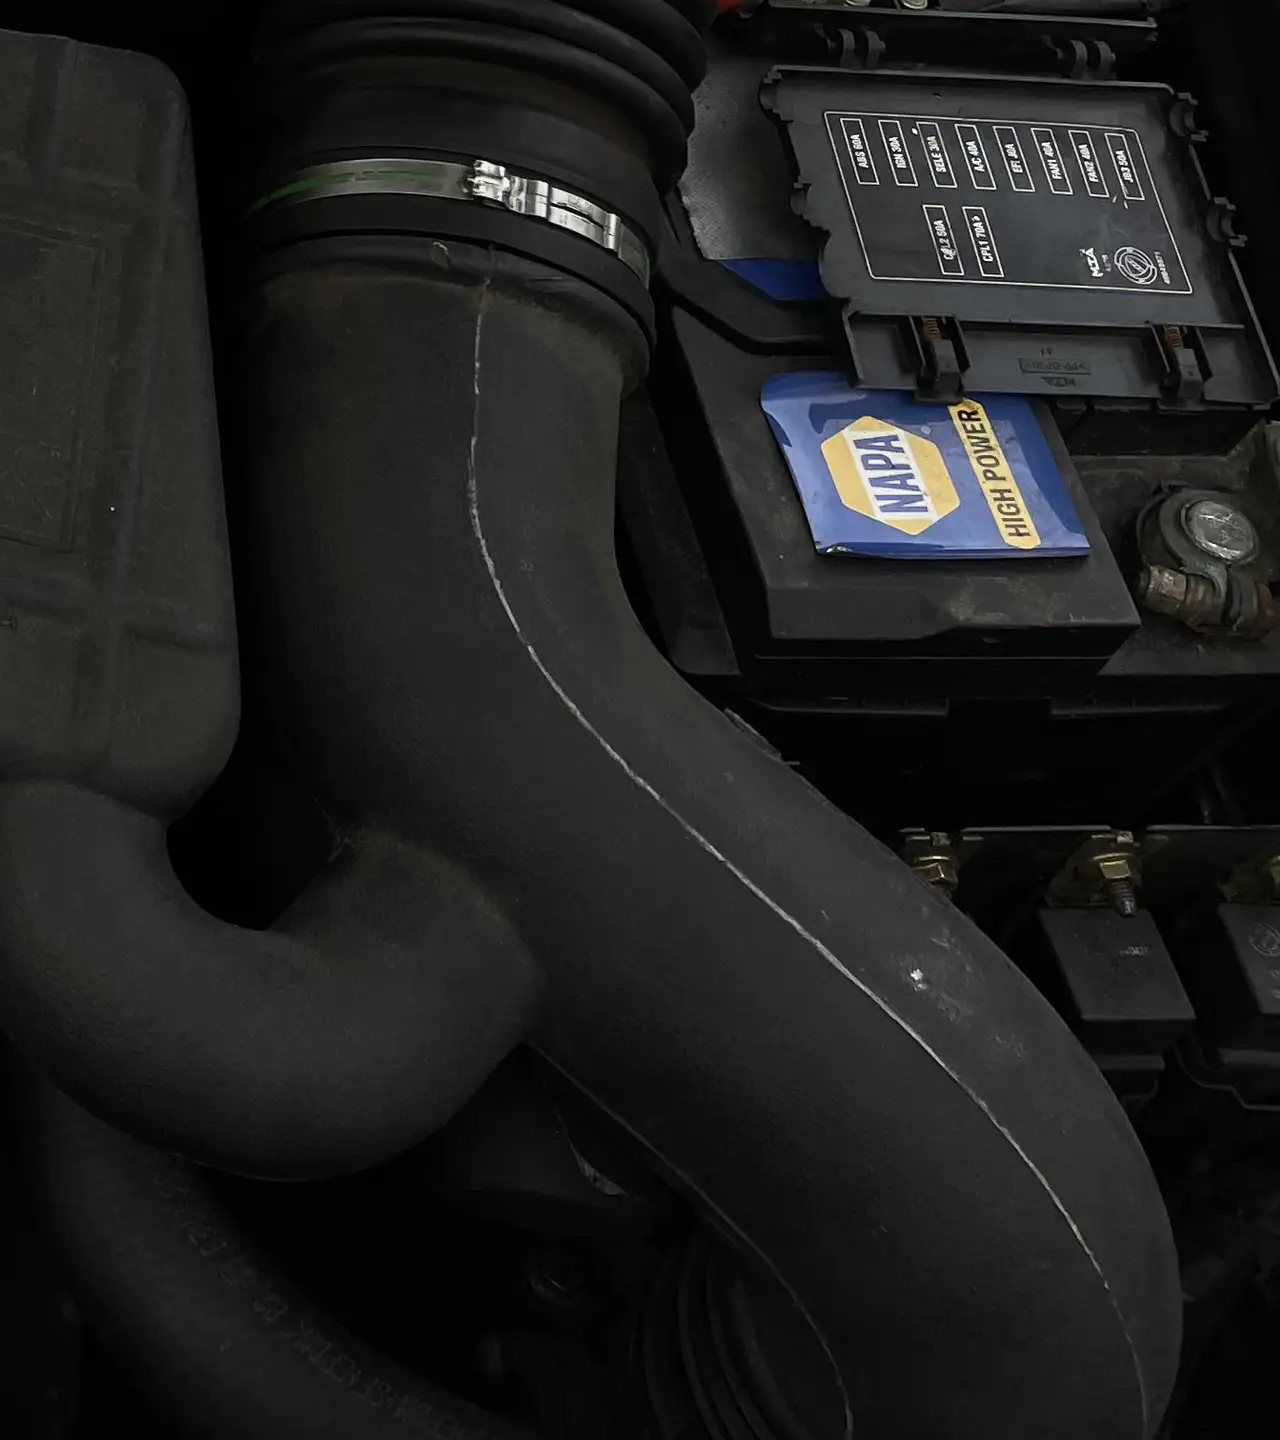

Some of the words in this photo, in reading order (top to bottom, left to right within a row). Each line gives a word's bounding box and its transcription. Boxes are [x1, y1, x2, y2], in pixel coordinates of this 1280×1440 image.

[850, 134, 864, 151] 60A
[889, 136, 902, 153] 30A
[926, 135, 940, 152] 30A
[965, 140, 980, 156] 40A
[854, 151, 869, 168] ABS
[1077, 144, 1091, 160] 40A
[1115, 150, 1129, 166] 50A
[893, 153, 907, 169] IGN
[931, 152, 947, 173] SELE
[1010, 160, 1023, 174] EFI
[1047, 159, 1063, 180] FAN1
[1083, 161, 1099, 183] FAN2
[972, 221, 987, 238] 70A
[978, 240, 994, 262] CPL1
[1084, 247, 1103, 278] MTA
[957, 408, 1007, 483] POWER
[852, 433, 928, 514] NAPA
[990, 488, 1032, 538] HIGH
